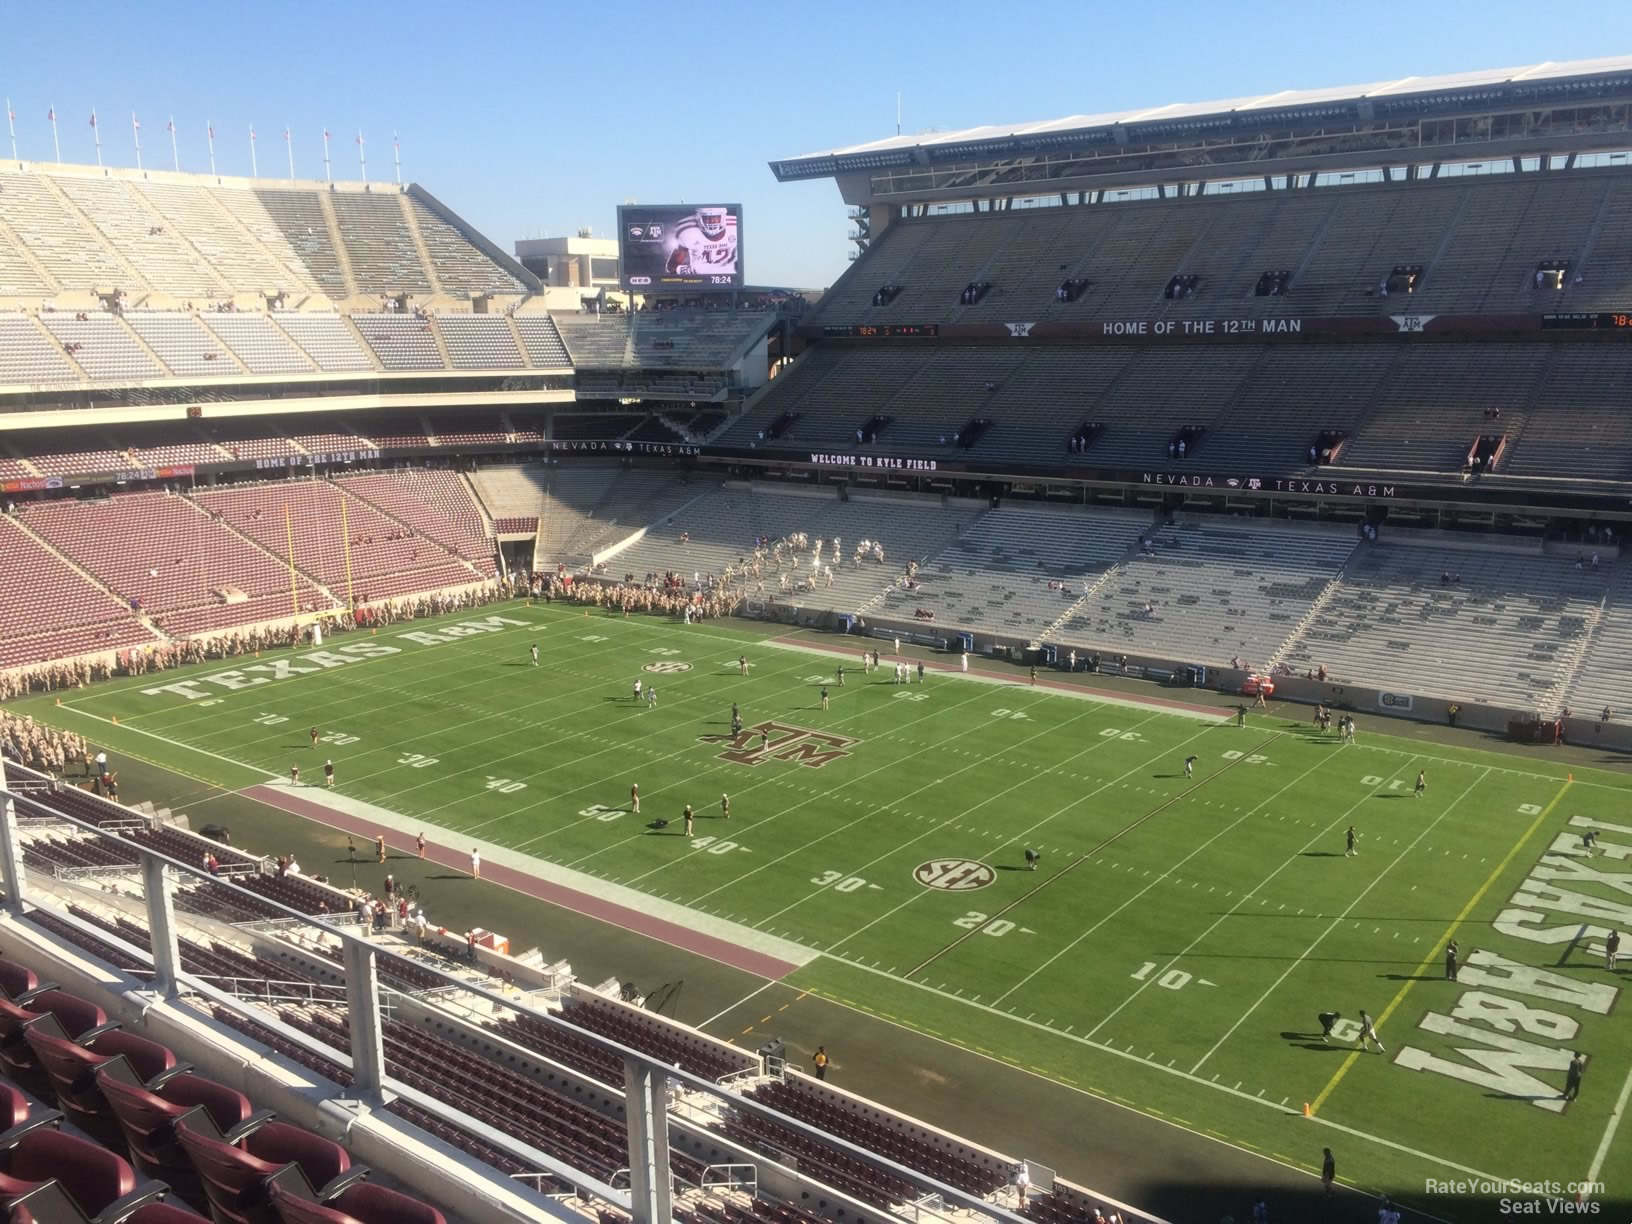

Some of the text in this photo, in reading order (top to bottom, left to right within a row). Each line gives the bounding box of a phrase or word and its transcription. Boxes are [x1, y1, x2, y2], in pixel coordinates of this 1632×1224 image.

[711, 276, 731, 284] 78:24
[1103, 319, 1302, 335] HOME OF THE 12TH MAN
[552, 442, 700, 455] NEVADA TEXAS A&M
[256, 450, 380, 469] HOME OF THE 12TH MAN
[811, 453, 937, 470] WELCOME TO KYLE FIELD
[115, 471, 140, 480] 78:24
[1143, 473, 1213, 487] NEVADA
[1276, 480, 1337, 494] TEXAS
[1353, 484, 1395, 497] A&M
[140, 616, 534, 700] TEXAS A&M
[892, 691, 930, 702] 50
[253, 714, 290, 725] 10
[991, 708, 1028, 719] 40
[320, 732, 361, 746] 20
[1098, 728, 1142, 741] 30
[397, 753, 440, 768] 30
[485, 779, 528, 794] 40
[1360, 775, 1405, 790] 10
[578, 804, 627, 821] 50
[690, 835, 739, 855] 40
[810, 870, 867, 893] 30
[918, 860, 992, 890] SEC
[952, 911, 1017, 937] 20
[1130, 961, 1193, 990] 10
[1330, 1019, 1364, 1041] G
[1391, 947, 1623, 1115] A&M
